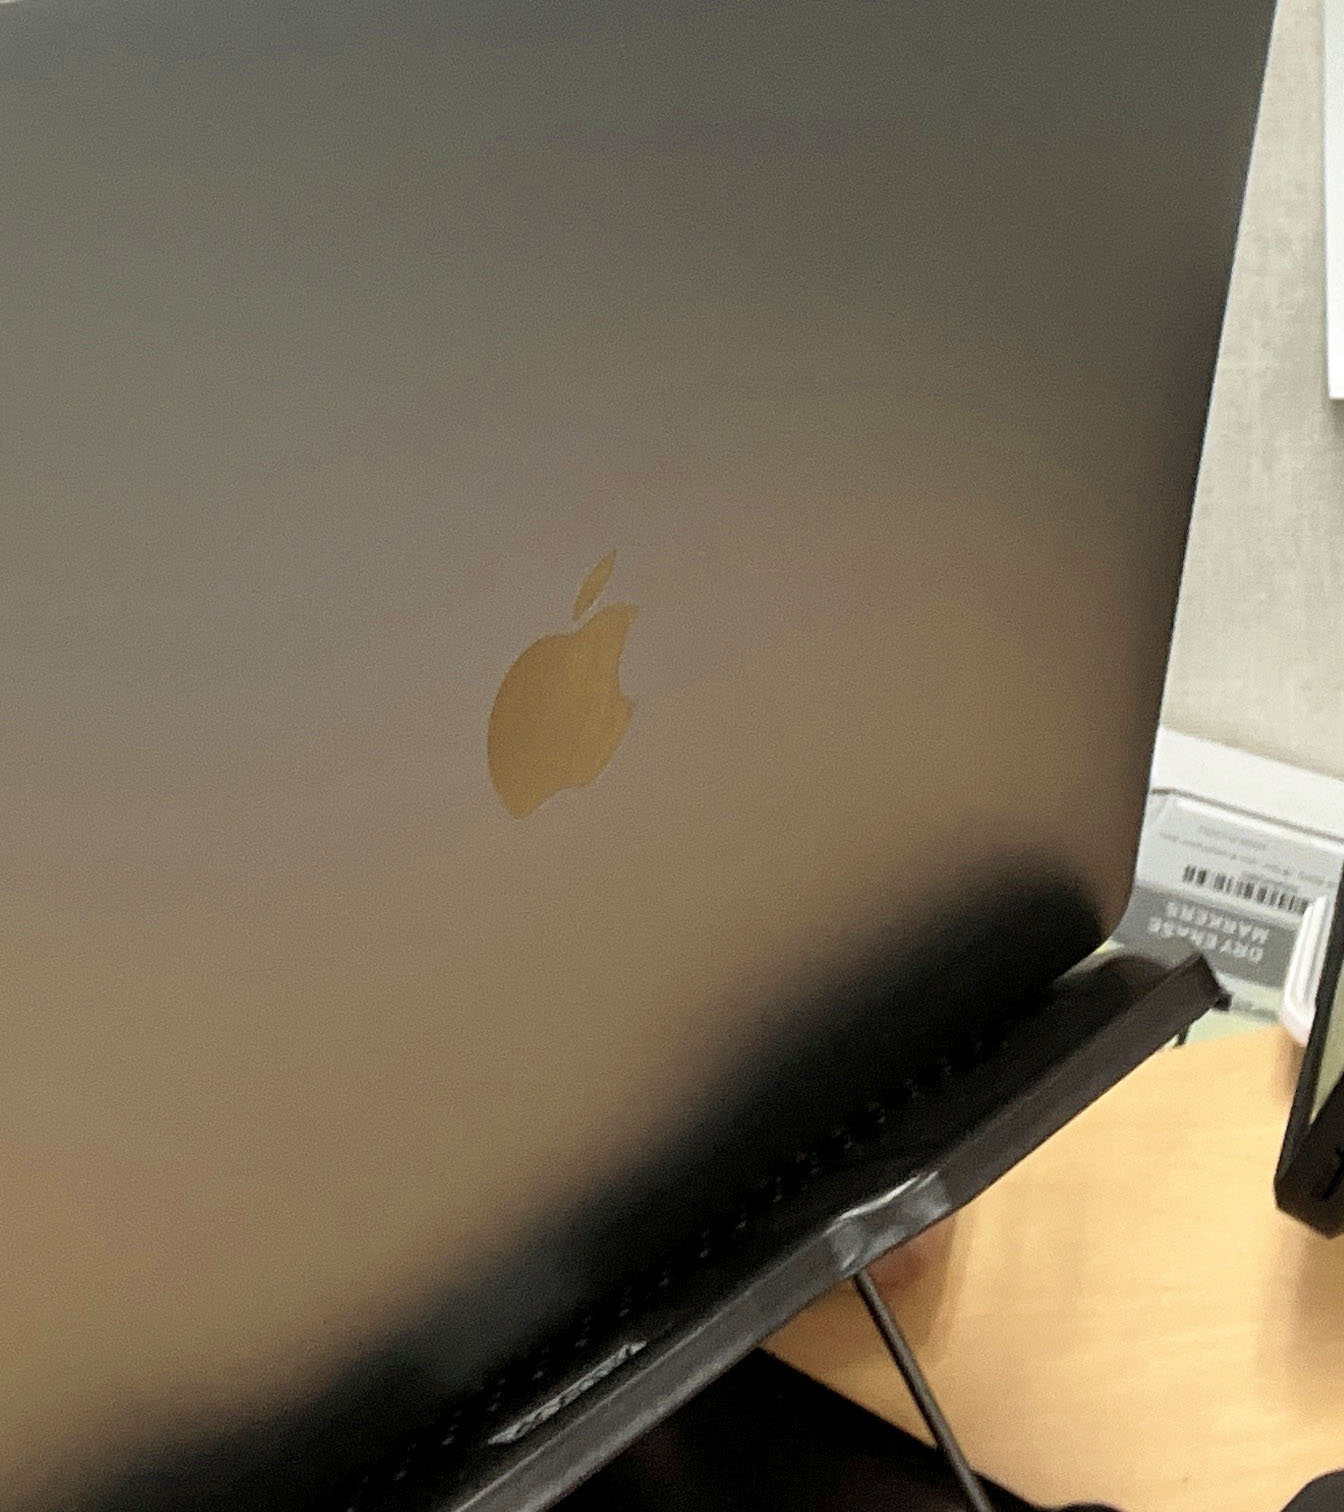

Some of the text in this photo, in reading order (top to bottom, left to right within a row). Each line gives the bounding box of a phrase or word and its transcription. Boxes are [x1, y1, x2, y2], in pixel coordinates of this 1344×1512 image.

[1147, 917, 1264, 964] DRY ERASE
[1166, 902, 1270, 944] MARKERS
